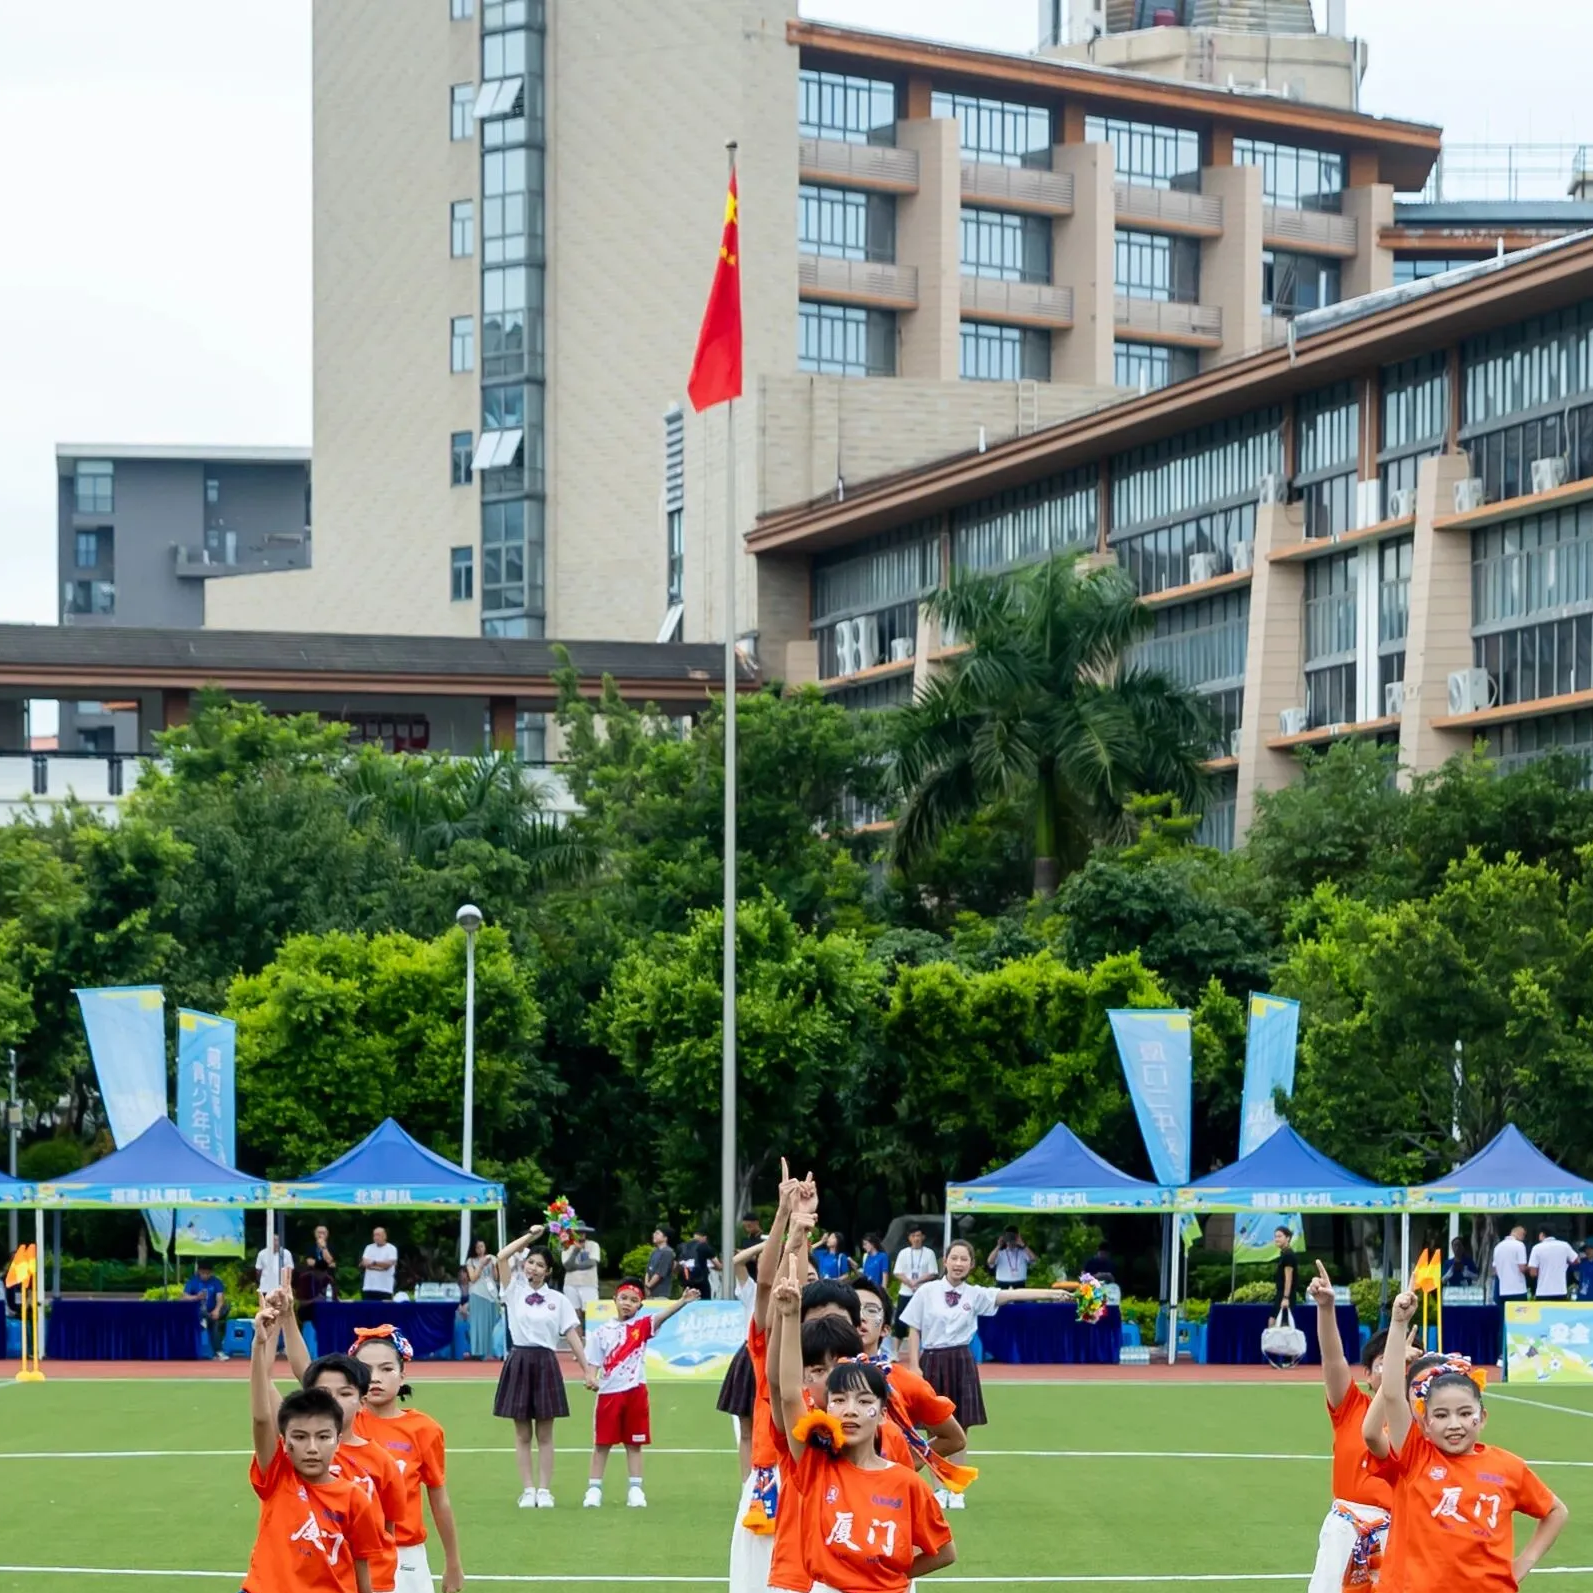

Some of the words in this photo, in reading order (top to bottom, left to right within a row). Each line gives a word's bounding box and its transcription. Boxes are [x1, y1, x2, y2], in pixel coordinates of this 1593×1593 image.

[1030, 1191, 1089, 1207] 北京女队
[1251, 1192, 1333, 1207] 福建1队女队
[1549, 1322, 1590, 1345] 安全
[1430, 1486, 1502, 1529] 厦门
[825, 1511, 897, 1557] 厦门
